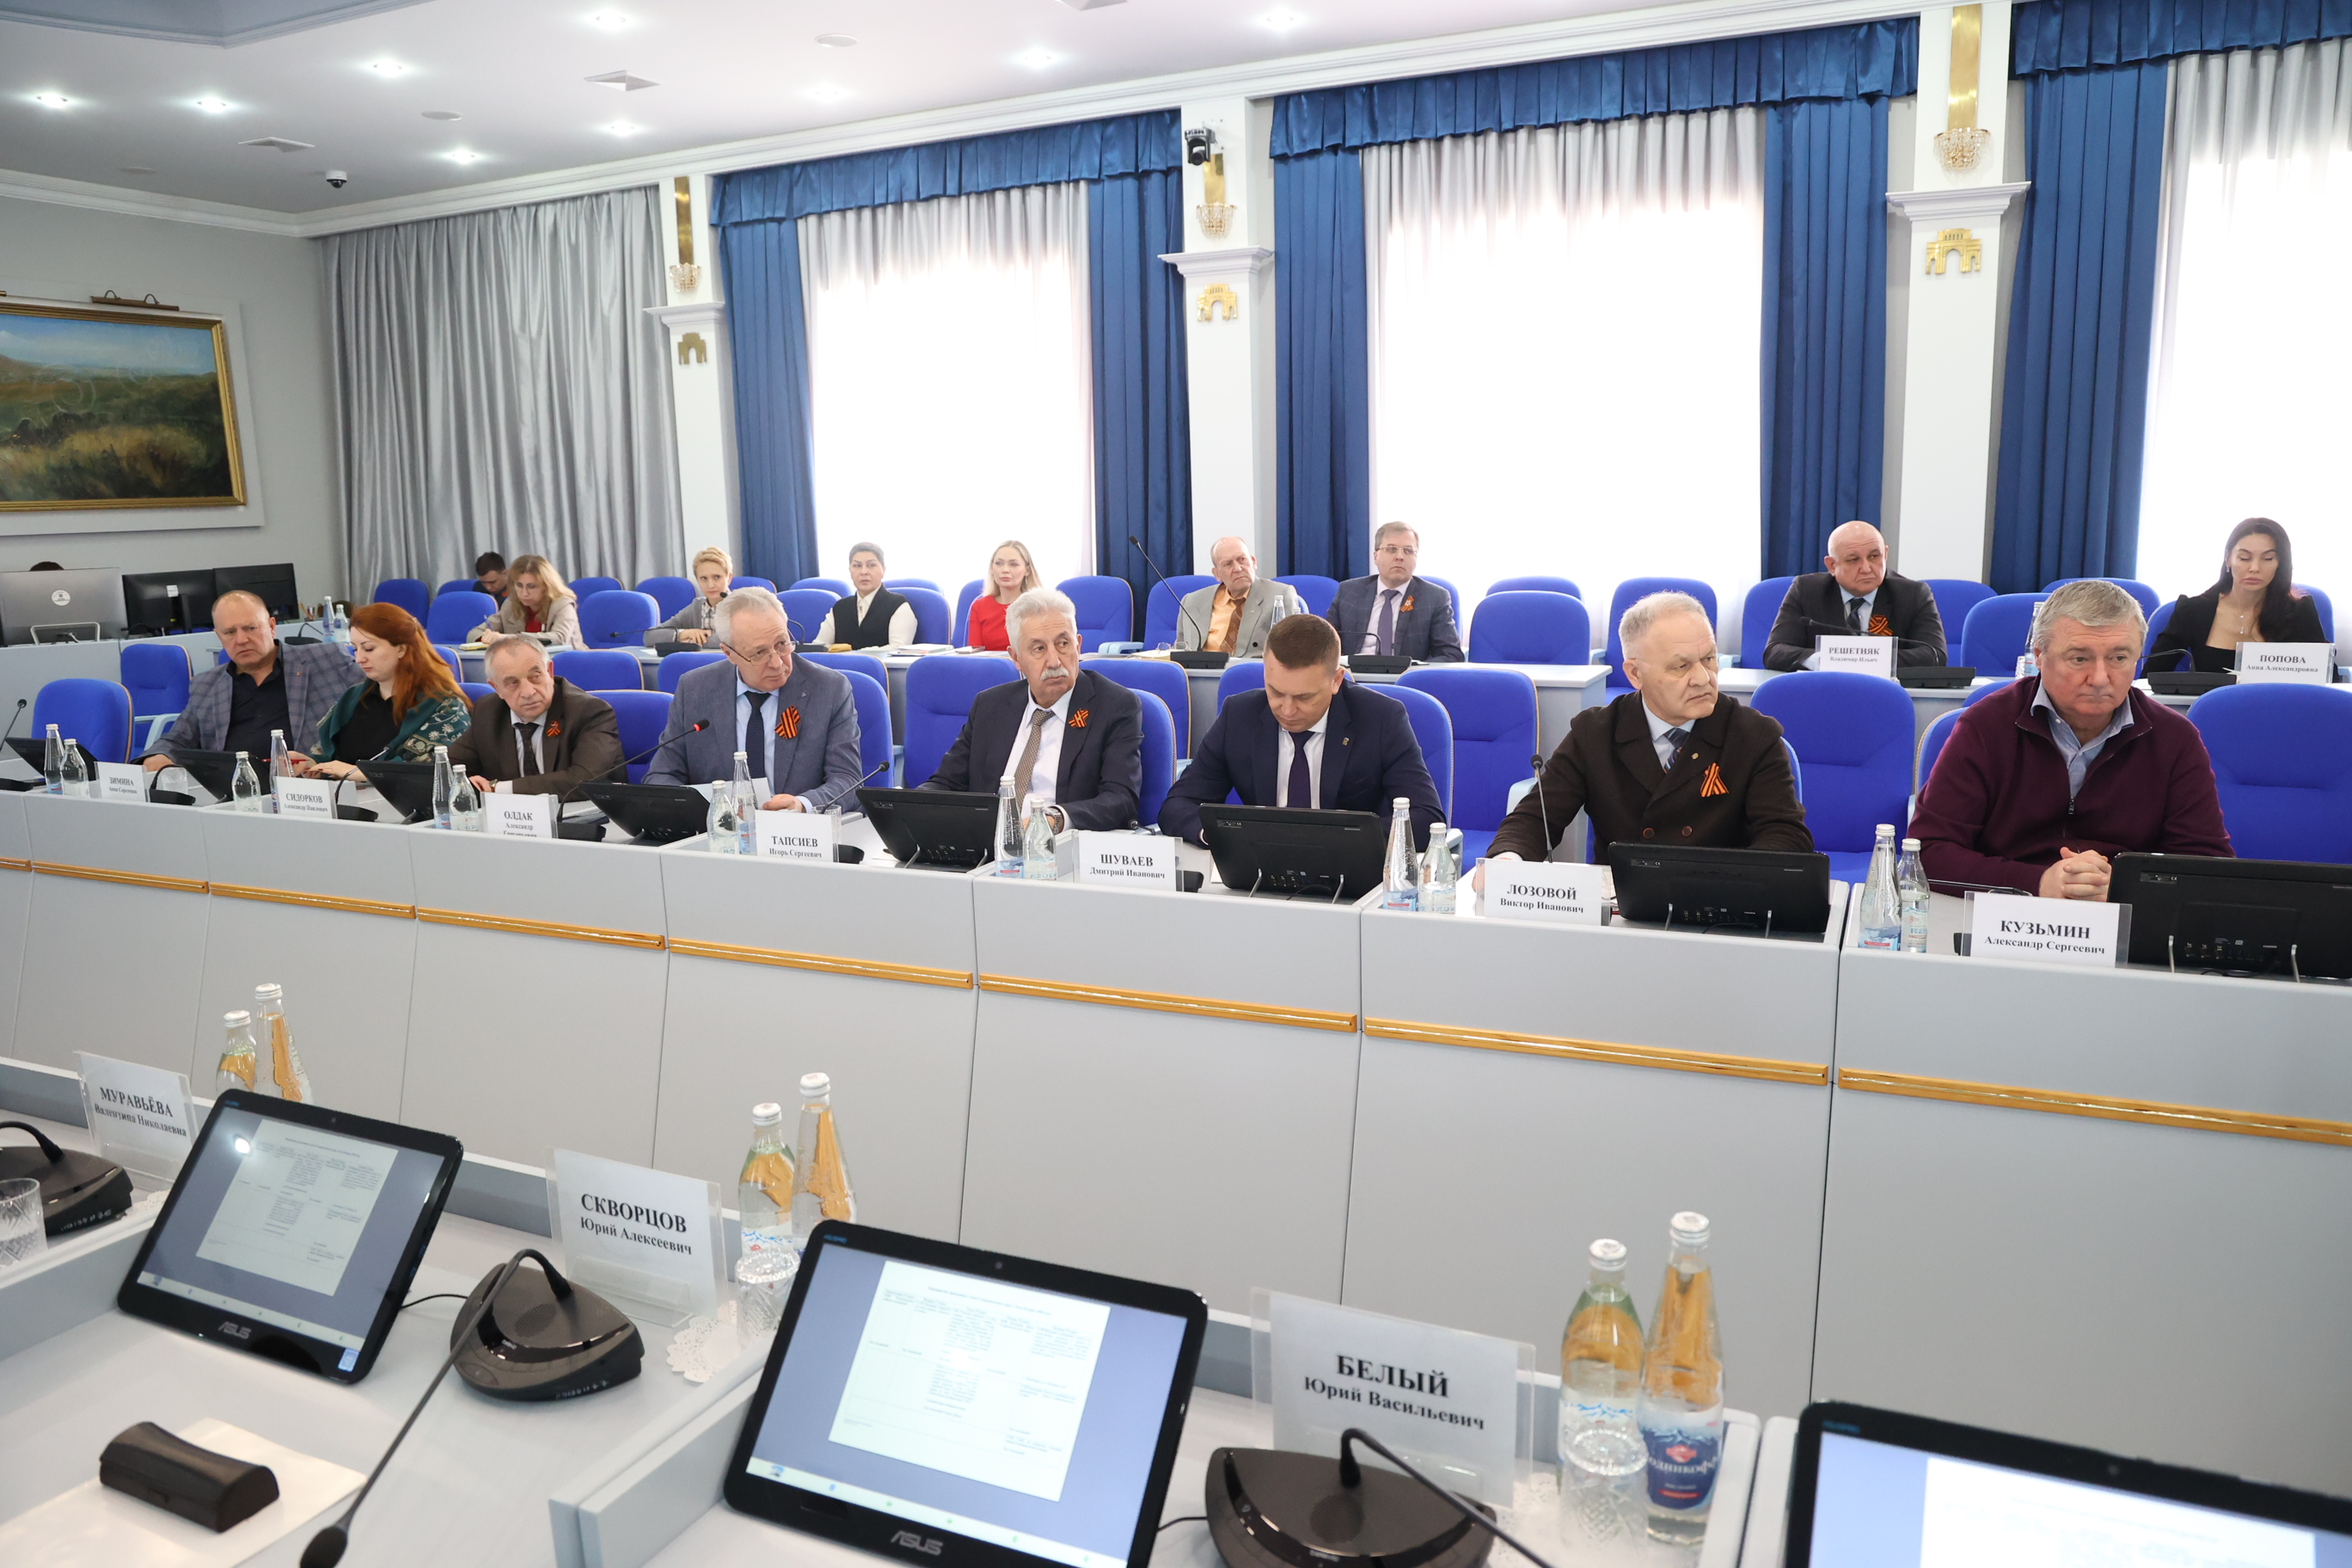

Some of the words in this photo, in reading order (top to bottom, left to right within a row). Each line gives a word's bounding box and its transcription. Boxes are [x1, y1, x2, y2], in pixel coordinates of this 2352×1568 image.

[1828, 646, 1880, 655] РЕШЕТНЯК
[2259, 654, 2306, 664] ПОПОВА
[2265, 665, 2318, 673] Александровна
[109, 776, 134, 787] ЗИМИНА
[285, 793, 323, 804] СИДОРКОВ
[504, 811, 533, 821] ОЛДАК
[505, 823, 534, 831] Александр
[770, 836, 818, 848] ТАПСИЕВ
[769, 848, 789, 857] Игорь
[789, 848, 822, 858] Сергеевич
[1100, 854, 1154, 867] ШУВАЕВ
[1089, 867, 1124, 878] Дмитрий
[1126, 869, 1165, 879] Иванович
[1506, 884, 1577, 900] ЛОЗОВОЙ
[1500, 897, 1534, 910] Виктор
[1537, 902, 1583, 914] Иванович
[2000, 920, 2091, 940] КУЗЬМИН
[1984, 936, 2043, 951] Александр
[2046, 940, 2105, 954] Сергеевич
[100, 1087, 174, 1118] МУРАВЬЁВА
[95, 1103, 137, 1124] Валентина
[138, 1114, 187, 1136] Николаевна
[580, 1193, 687, 1233] СКВОРЦОВ
[580, 1216, 617, 1237] Юрий
[620, 1227, 692, 1255] Алексеевич
[217, 1321, 252, 1339] ASUS
[1336, 1354, 1449, 1398] БЕЛЫЙ
[1304, 1376, 1362, 1403] Юрий
[1369, 1391, 1485, 1430] Васильевич
[891, 1530, 944, 1556] ASUS
